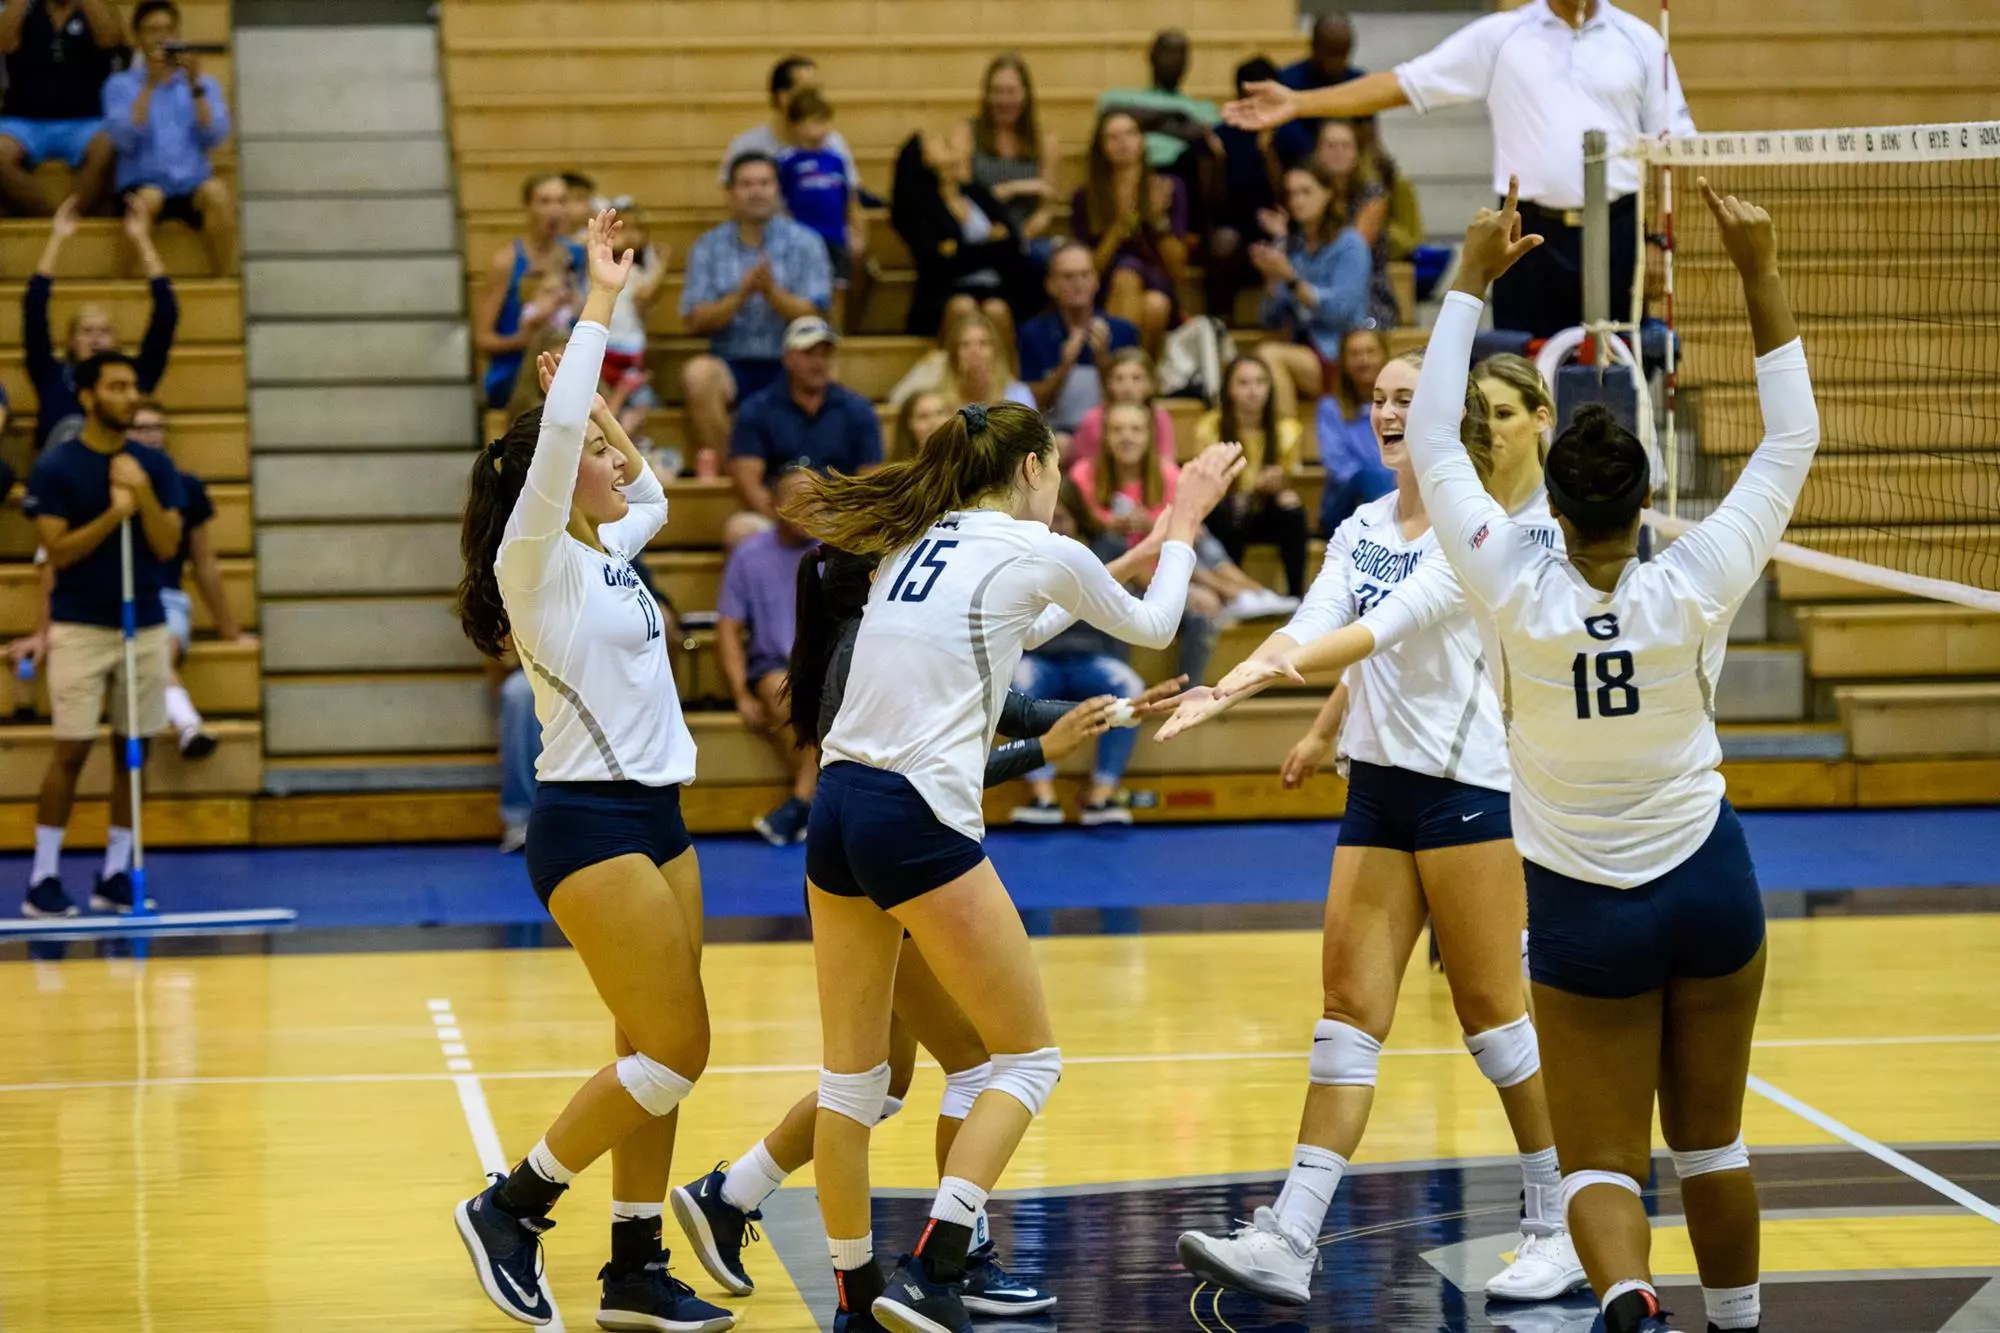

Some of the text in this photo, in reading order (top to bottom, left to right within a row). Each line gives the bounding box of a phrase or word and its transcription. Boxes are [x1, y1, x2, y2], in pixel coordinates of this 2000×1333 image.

[886, 539, 959, 602] 15
[637, 588, 660, 642] 12
[1584, 613, 1620, 641] G
[1572, 650, 1640, 719] 18
